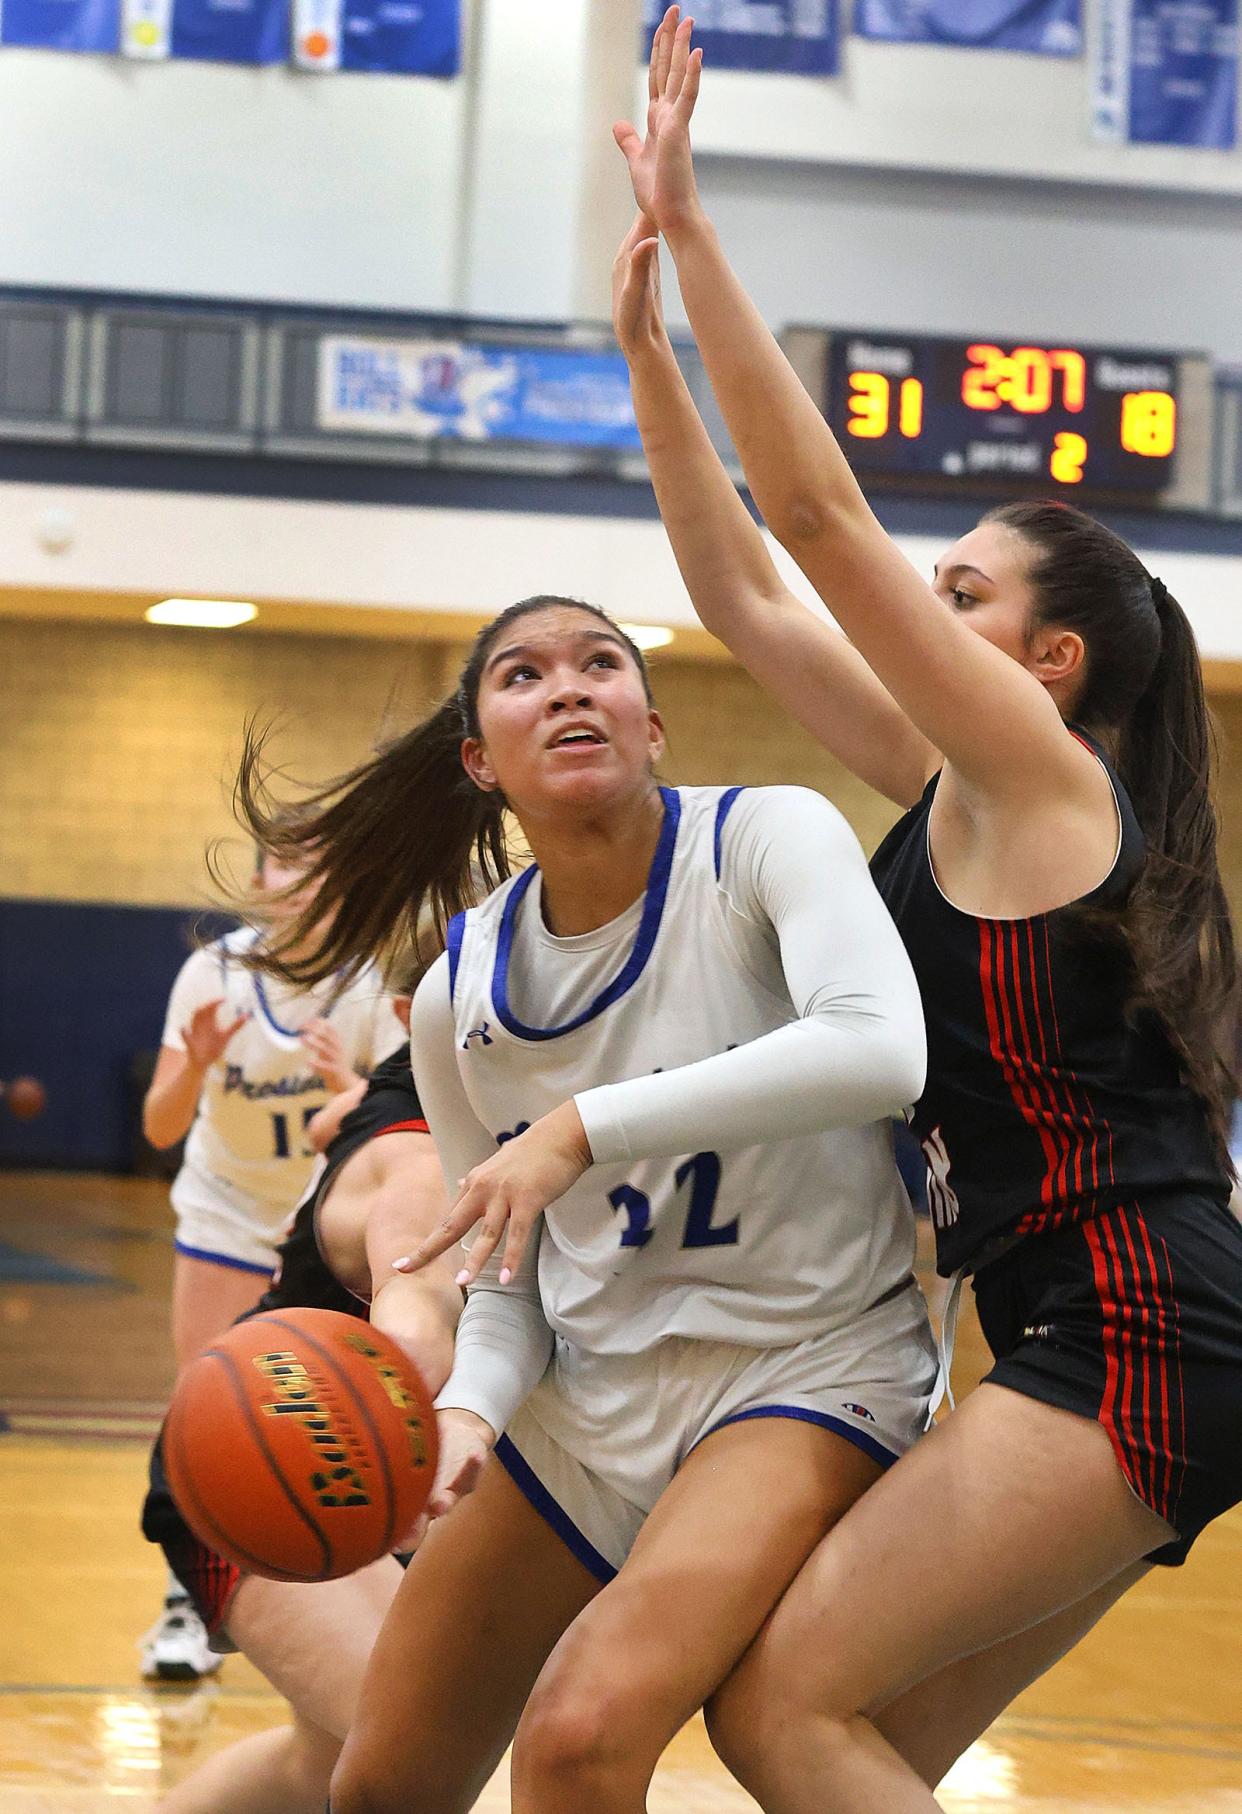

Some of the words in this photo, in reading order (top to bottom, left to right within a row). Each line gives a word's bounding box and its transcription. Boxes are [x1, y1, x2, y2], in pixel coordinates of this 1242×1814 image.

[847, 371, 923, 439] 31
[962, 344, 1086, 414] 2:07
[1050, 431, 1088, 484] 2
[1120, 389, 1177, 458] 18
